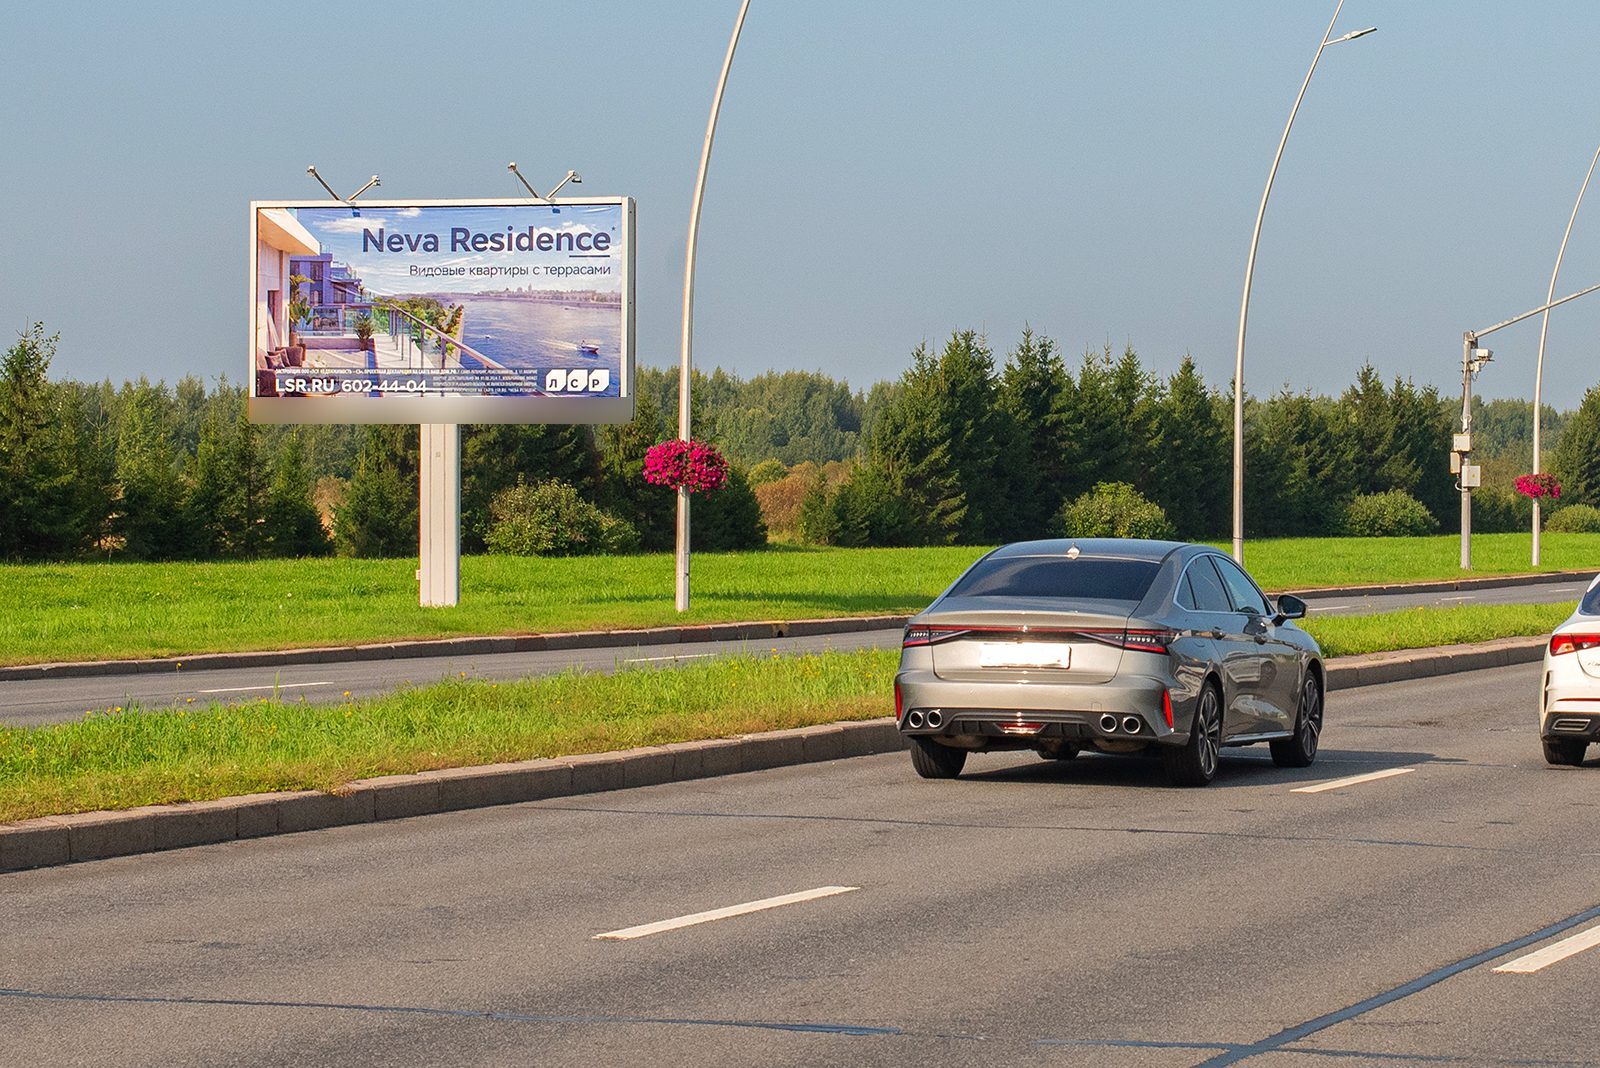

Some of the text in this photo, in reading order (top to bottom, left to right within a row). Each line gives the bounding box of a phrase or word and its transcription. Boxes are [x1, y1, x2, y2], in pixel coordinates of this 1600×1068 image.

[362, 227, 439, 252] Neva
[409, 264, 611, 278] Видовые квартиры с террасами
[275, 378, 335, 392] LSR.RU
[341, 379, 427, 393] 602-44-04
